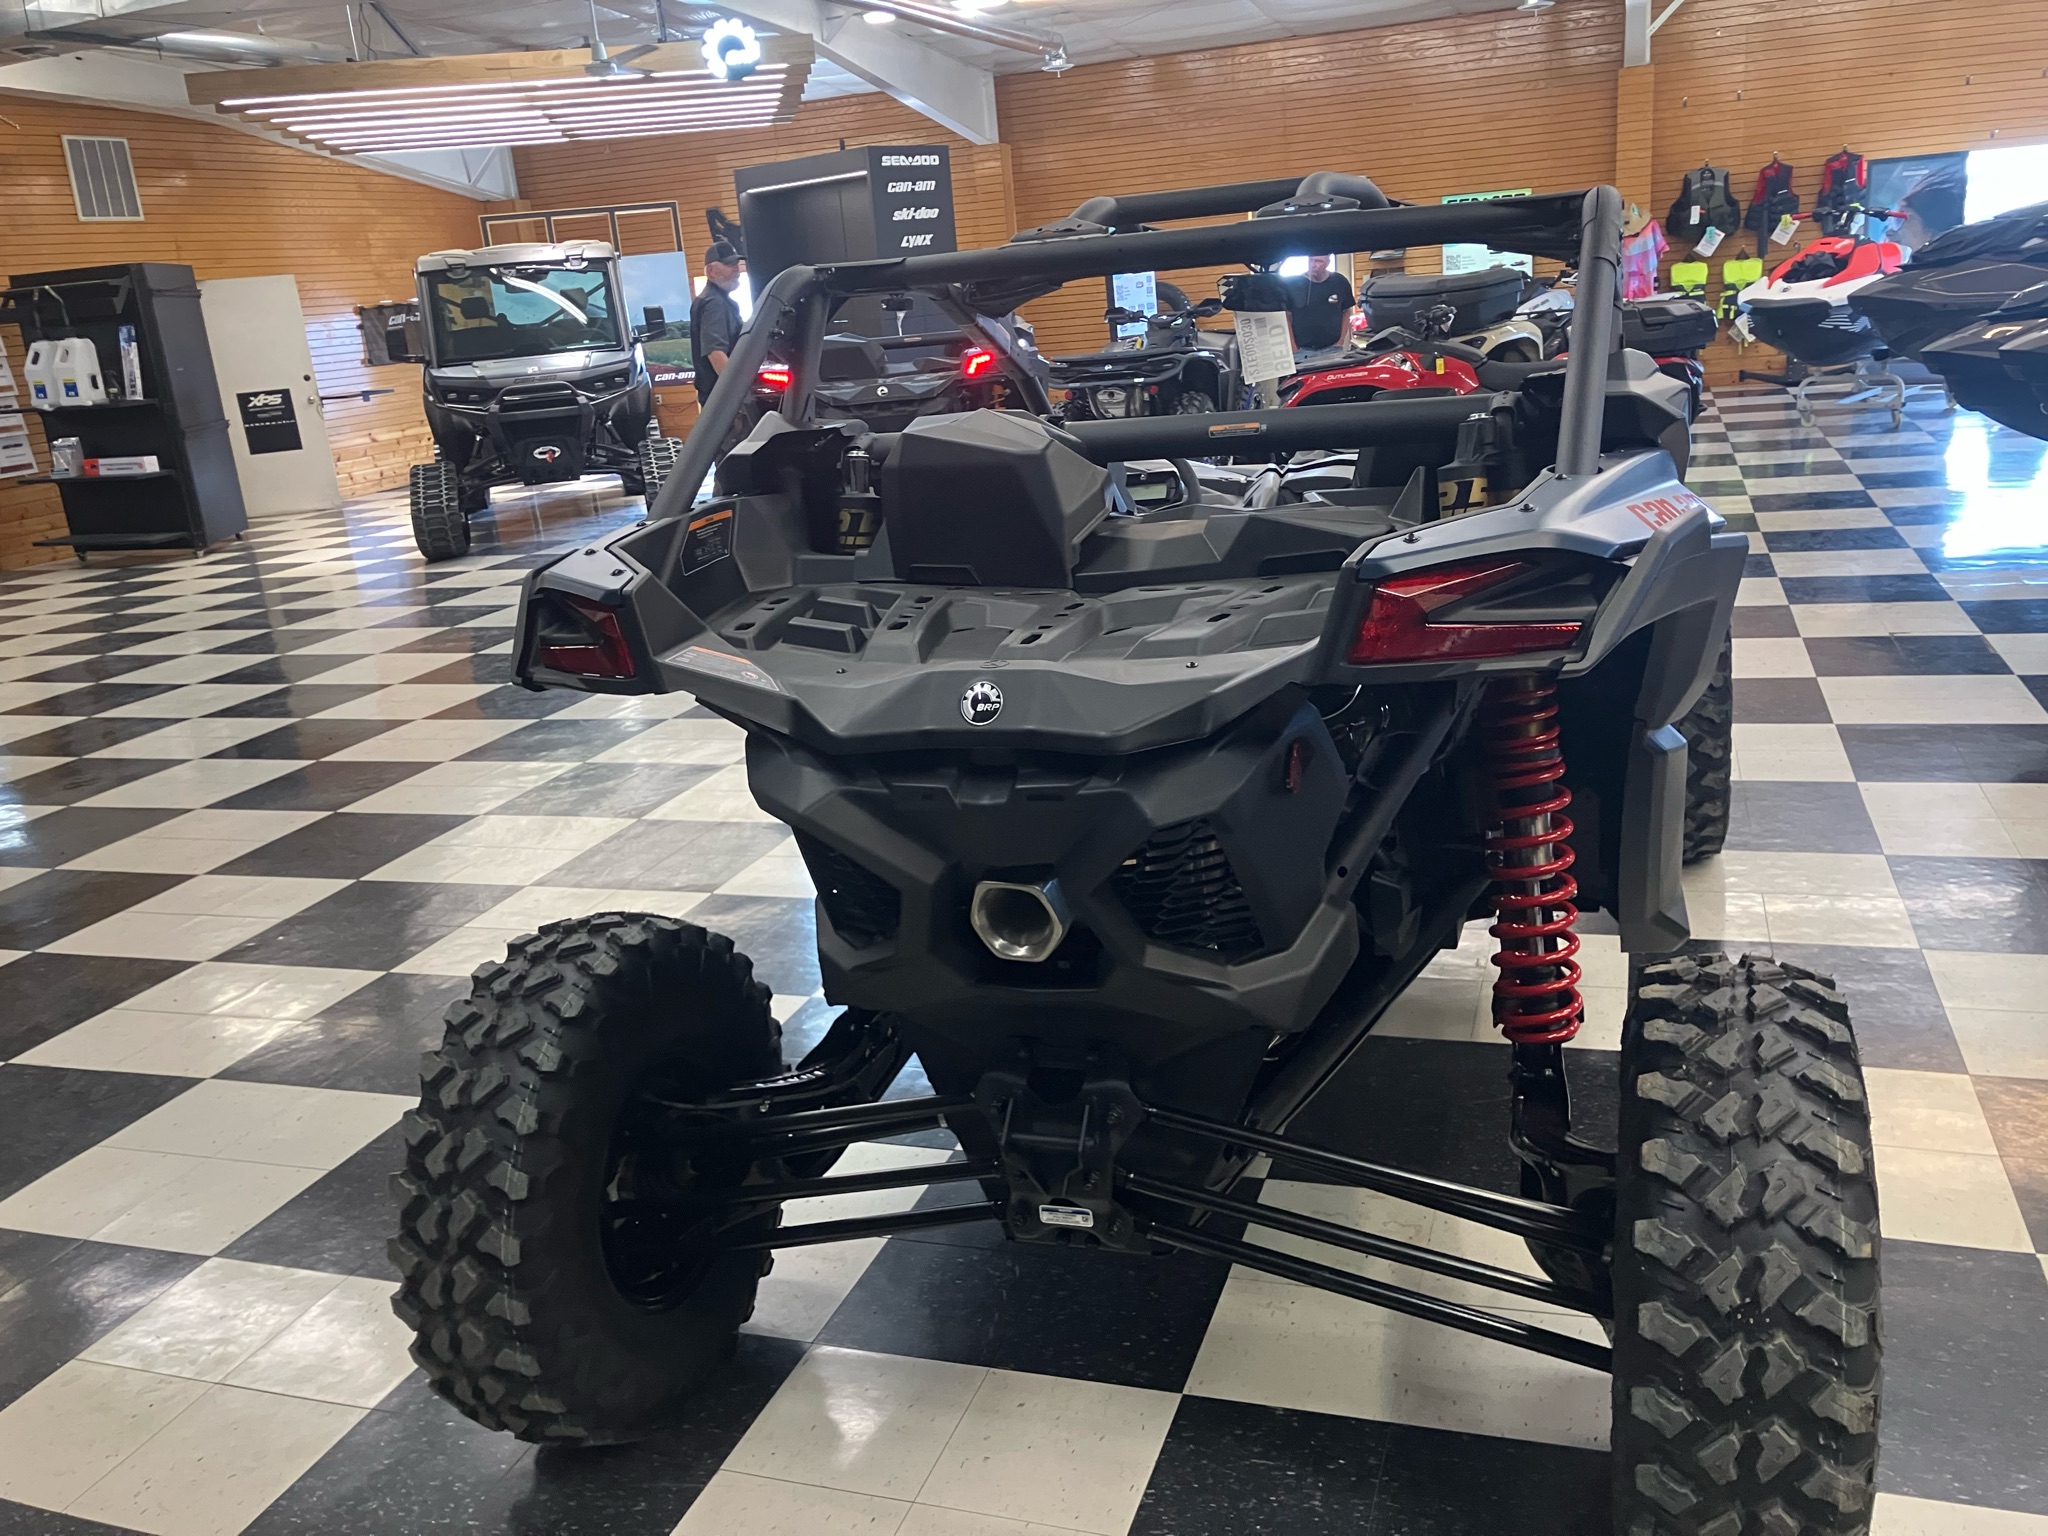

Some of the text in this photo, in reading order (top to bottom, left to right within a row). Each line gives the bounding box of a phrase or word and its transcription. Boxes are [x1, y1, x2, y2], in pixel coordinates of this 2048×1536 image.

[887, 180, 936, 193] can-am
[892, 206, 939, 221] ski-doo
[900, 233, 934, 248] LYNX
[654, 371, 696, 382] can-am
[247, 393, 283, 408] XPS
[976, 703, 1001, 712] BRP
